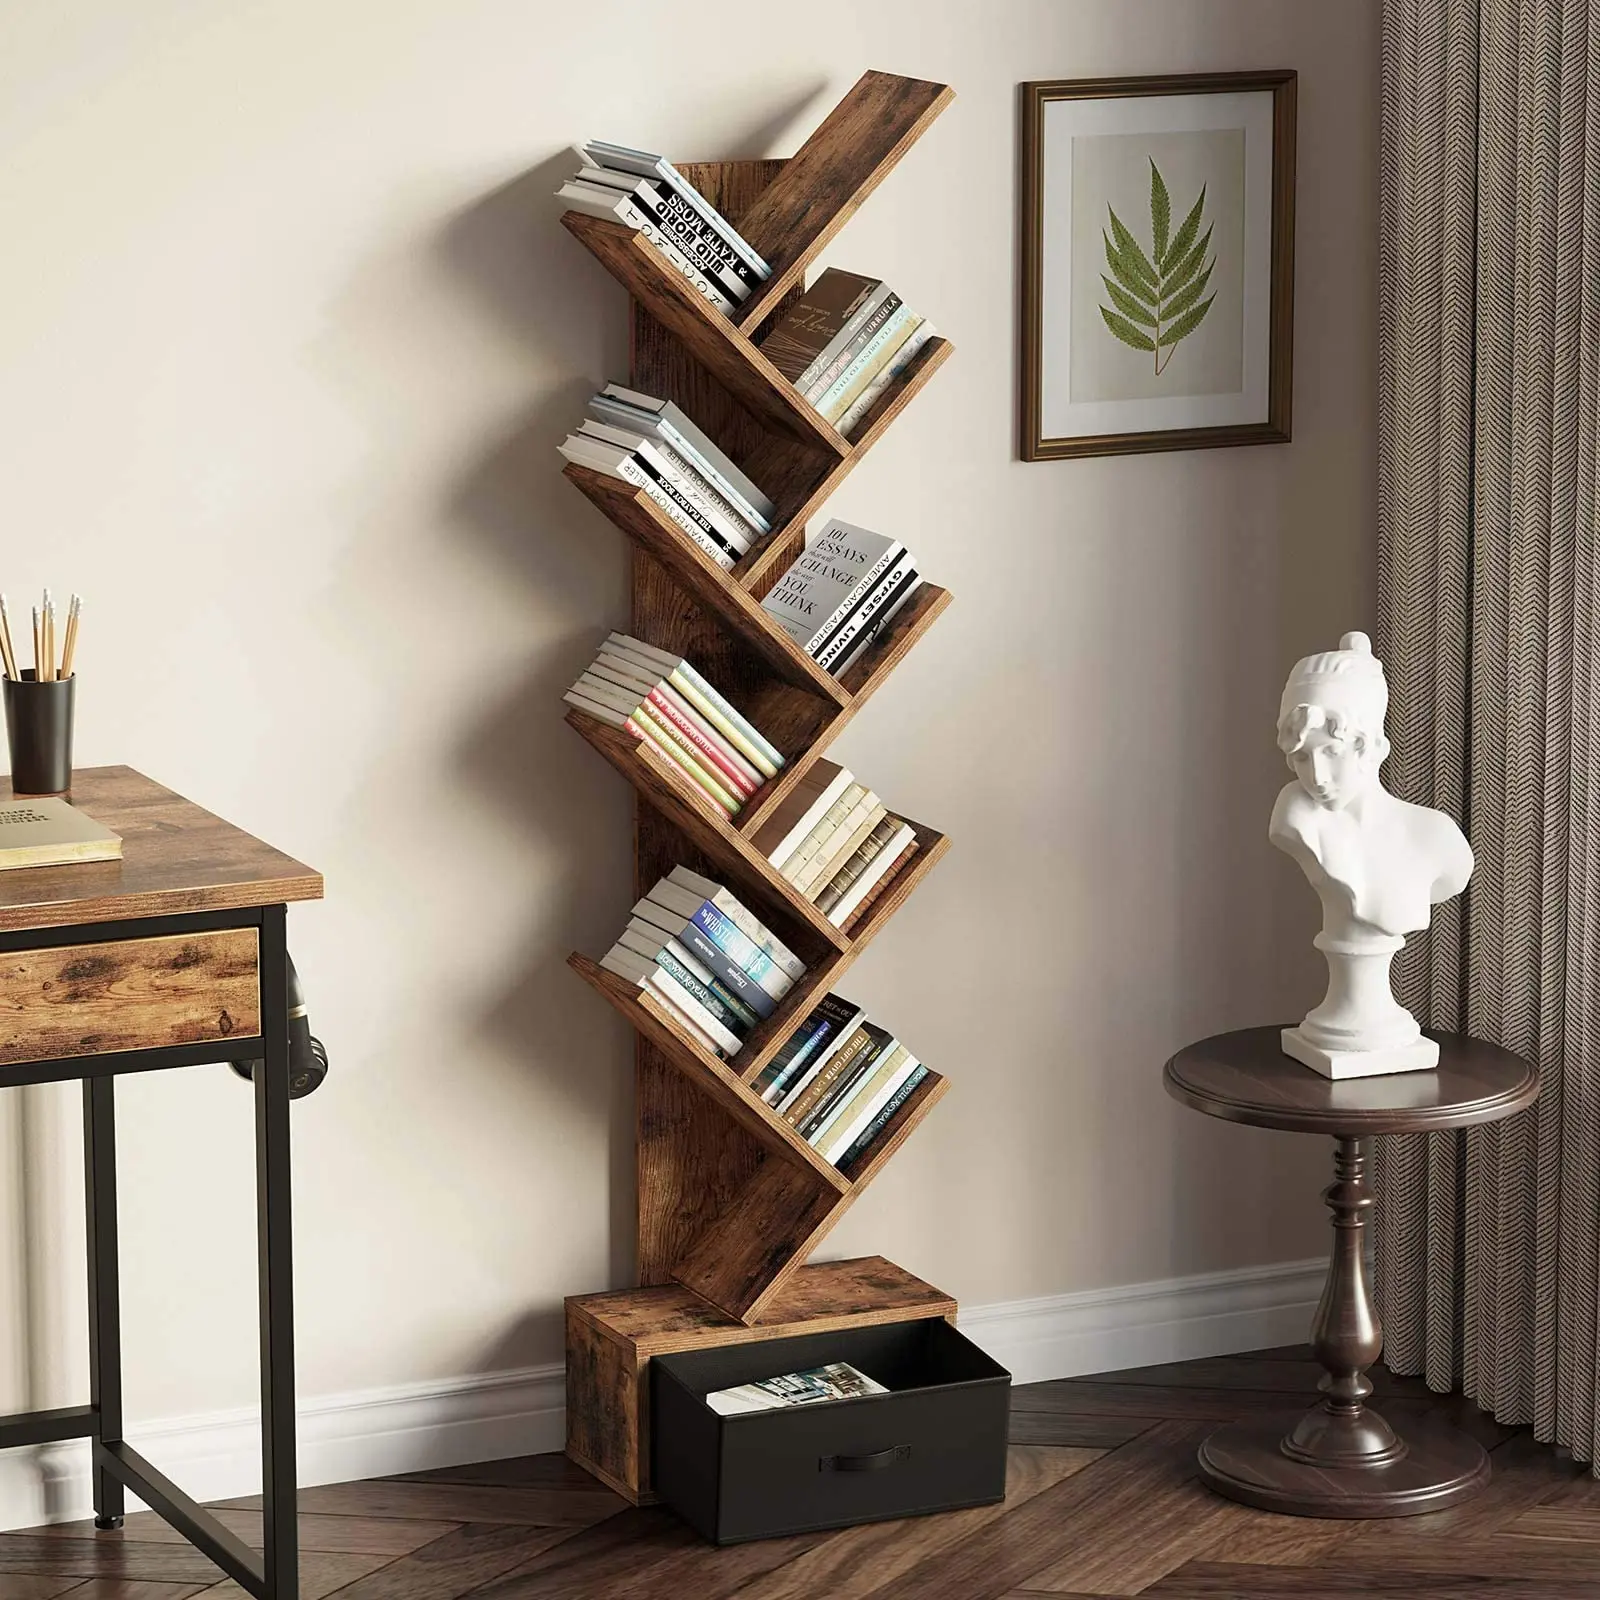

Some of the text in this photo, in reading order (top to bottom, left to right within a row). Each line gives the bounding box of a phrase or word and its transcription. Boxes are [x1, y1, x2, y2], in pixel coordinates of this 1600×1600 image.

[666, 192, 707, 233] MOSS
[653, 200, 726, 273] WILD WORLD
[658, 222, 707, 271] ACCESSORIES
[701, 228, 741, 268] KATE
[864, 298, 899, 333] URRUELA
[665, 449, 689, 472] TELLER
[622, 462, 650, 491] TELLER
[687, 470, 710, 493] STORY
[648, 487, 675, 515] STORY
[656, 475, 712, 531] THE PLAYBOY BOOK
[707, 491, 736, 519] WALKER
[672, 511, 706, 546] WALKER
[828, 528, 848, 541] 101
[816, 539, 868, 564] ESSAYS
[783, 576, 814, 595] YOU
[800, 558, 857, 587] CHANGE
[772, 587, 818, 615] THINK
[803, 554, 893, 655] AMERICAN FASHION
[817, 569, 904, 667] GYPSET LIVING
[838, 1046, 854, 1063] GIFT
[850, 1033, 865, 1049] THE
[823, 1059, 843, 1080] GIVER
